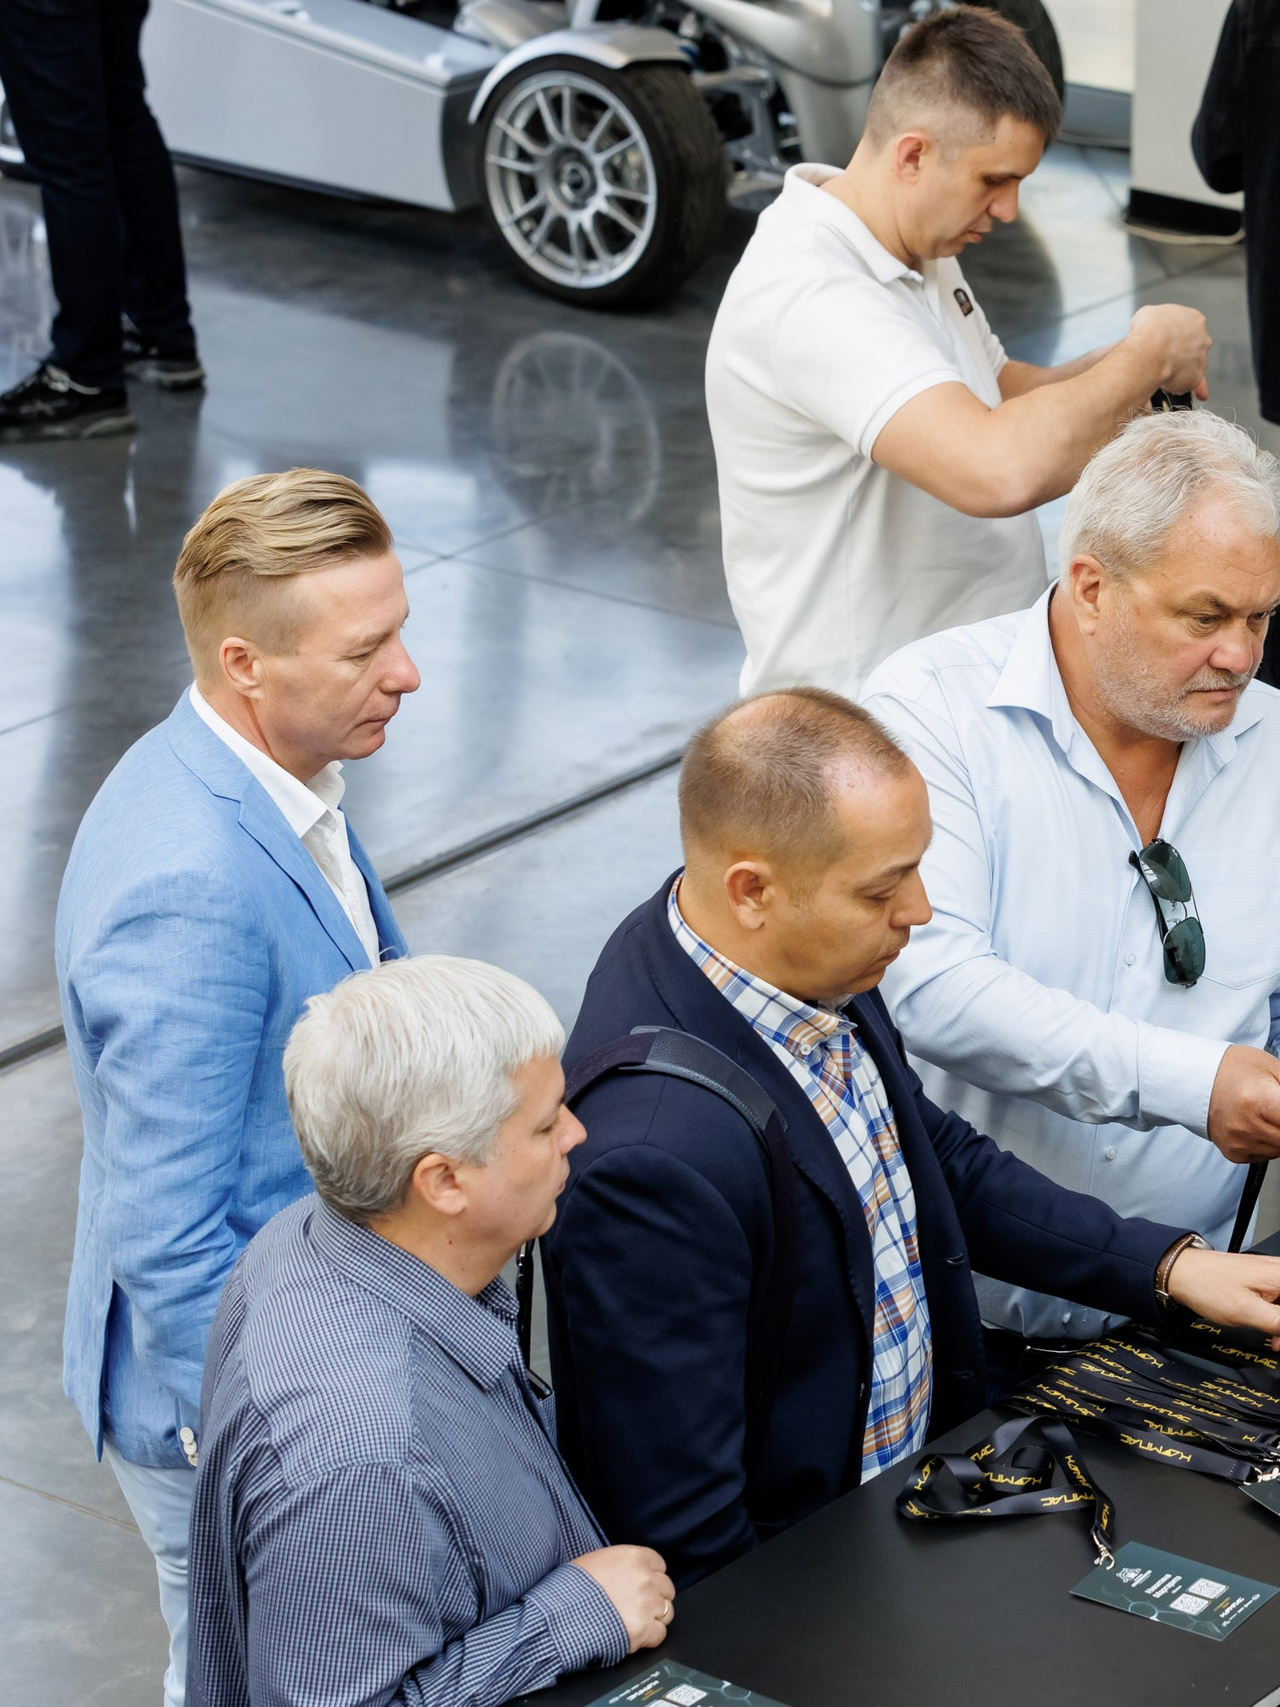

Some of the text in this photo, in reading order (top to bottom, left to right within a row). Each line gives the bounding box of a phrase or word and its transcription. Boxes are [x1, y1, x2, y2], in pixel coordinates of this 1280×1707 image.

[1211, 1343, 1278, 1370] КОМПАС
[1036, 1383, 1096, 1417] КОМПАС
[1200, 1381, 1264, 1408] КОМПАС
[1214, 1377, 1280, 1404] КОМПАС
[1125, 1396, 1192, 1423] КОМПАС
[1120, 1433, 1192, 1463] КОМПАС
